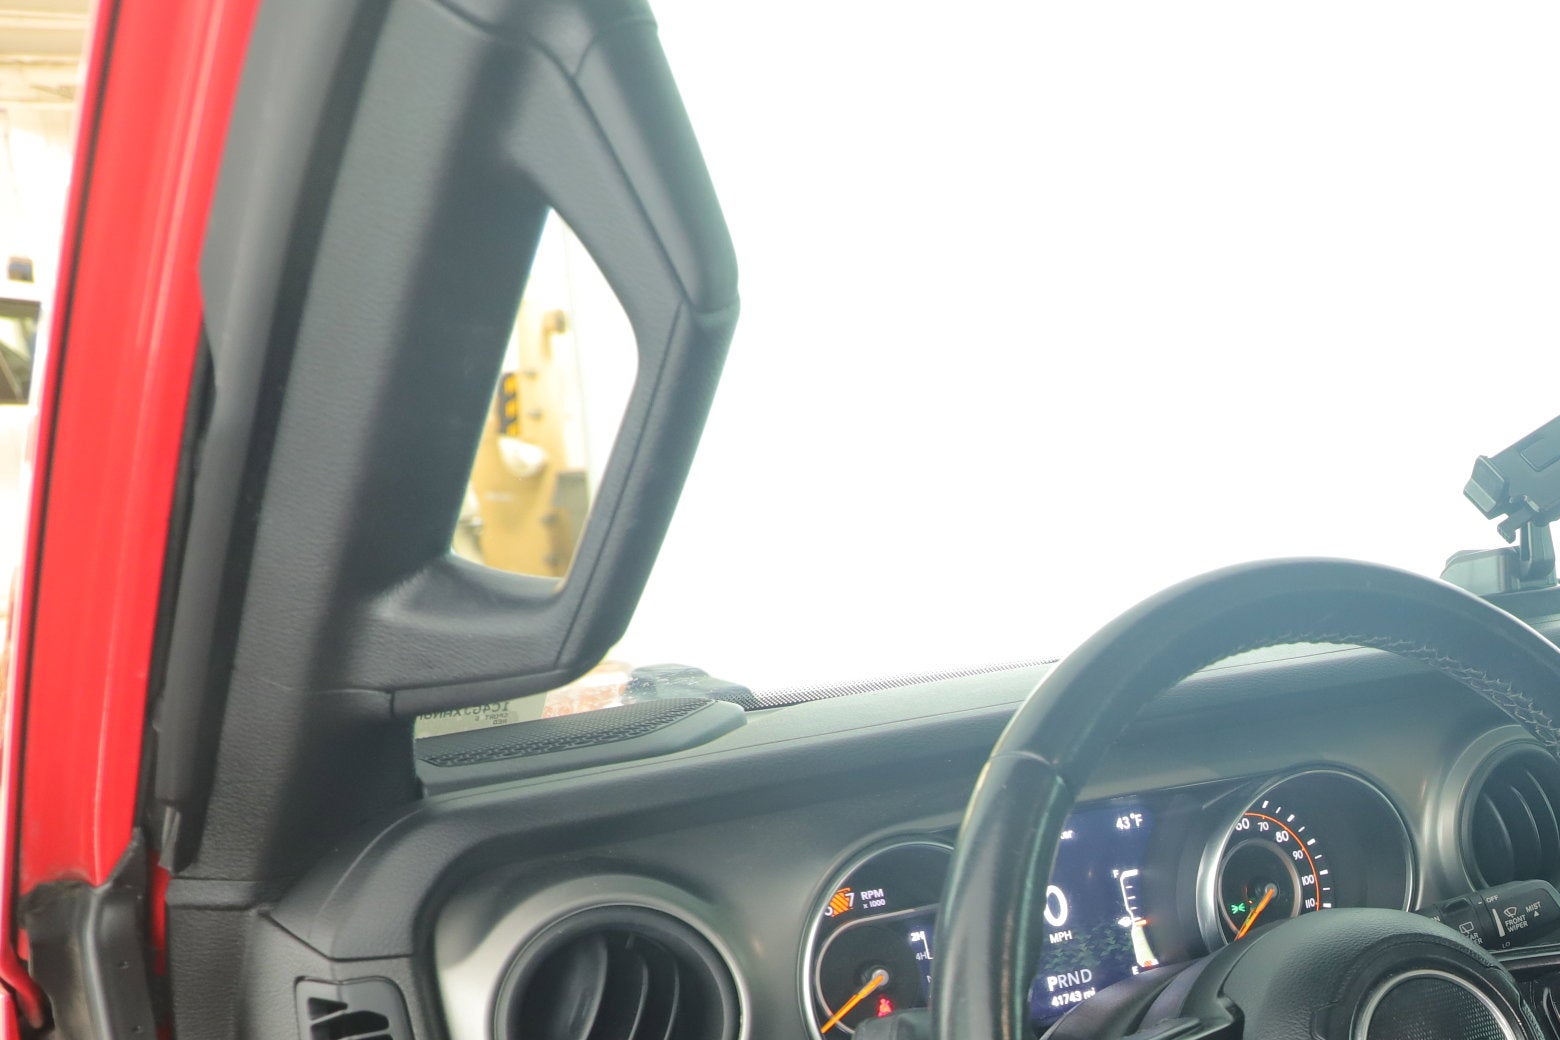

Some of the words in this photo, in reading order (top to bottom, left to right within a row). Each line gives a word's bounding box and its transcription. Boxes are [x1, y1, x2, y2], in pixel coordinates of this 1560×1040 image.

[1116, 812, 1144, 831] 43°F
[1236, 818, 1250, 830] 60
[1258, 821, 1270, 832] 70
[1276, 830, 1290, 843] 80
[1292, 850, 1304, 860] 90
[1112, 869, 1120, 879] F
[1302, 874, 1314, 886] 100
[846, 892, 855, 907] 7
[860, 888, 884, 901] RPM
[869, 898, 886, 908] 1000
[1305, 898, 1316, 908] 110
[1486, 894, 1499, 904] OFF
[1044, 884, 1068, 927] 0
[1525, 900, 1542, 914] MIST
[1505, 914, 1526, 927] FRONT
[1506, 920, 1529, 933] WIPER
[1050, 930, 1073, 944] MPH
[1132, 966, 1140, 976] E
[1052, 992, 1083, 1008] 41743
[1084, 987, 1096, 999] mi
